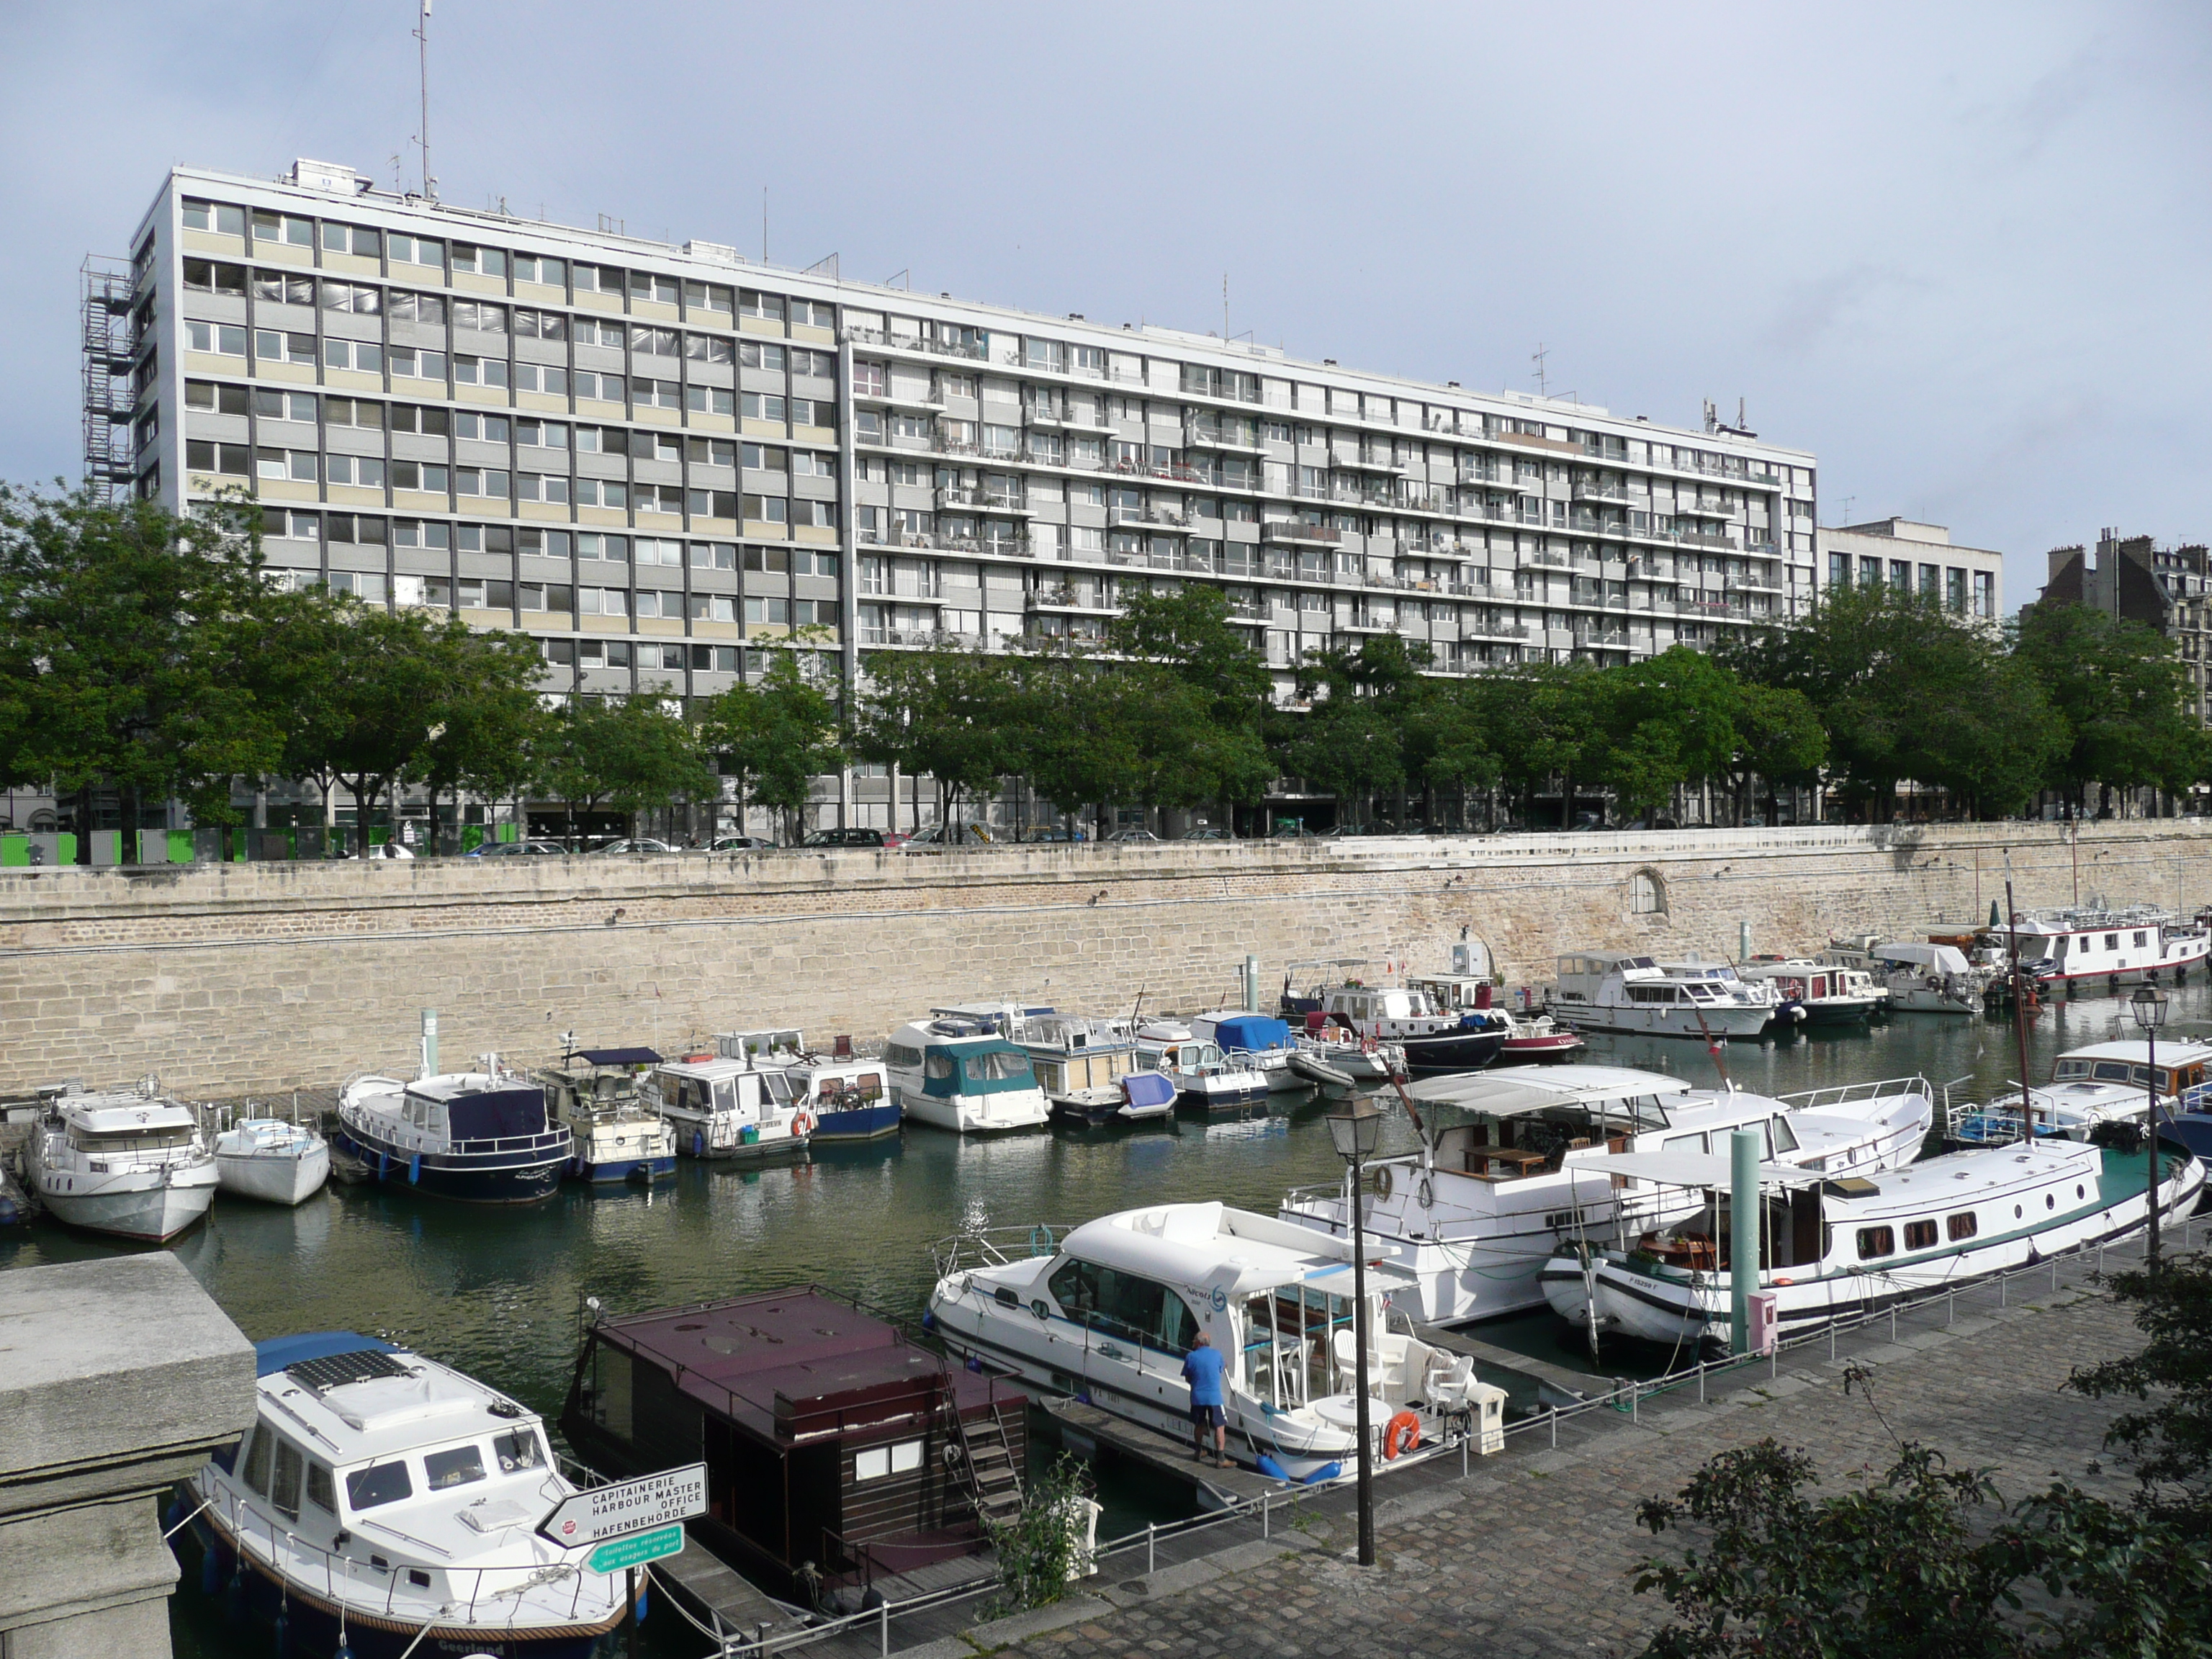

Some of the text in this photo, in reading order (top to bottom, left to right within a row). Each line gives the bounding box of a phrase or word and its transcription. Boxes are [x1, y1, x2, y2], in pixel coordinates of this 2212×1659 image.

[593, 1477, 675, 1504] CAPITAINERIE
[593, 1482, 701, 1516] HARBOUR MASTER
[661, 1492, 701, 1509] OFFICE
[593, 1506, 686, 1538] HAFENBEHÖRDE
[605, 1532, 676, 1556] toilettes réservées
[619, 1549, 648, 1562] usagers
[652, 1545, 661, 1553] du
[664, 1539, 679, 1550] port
[438, 1640, 505, 1655] Geerland
